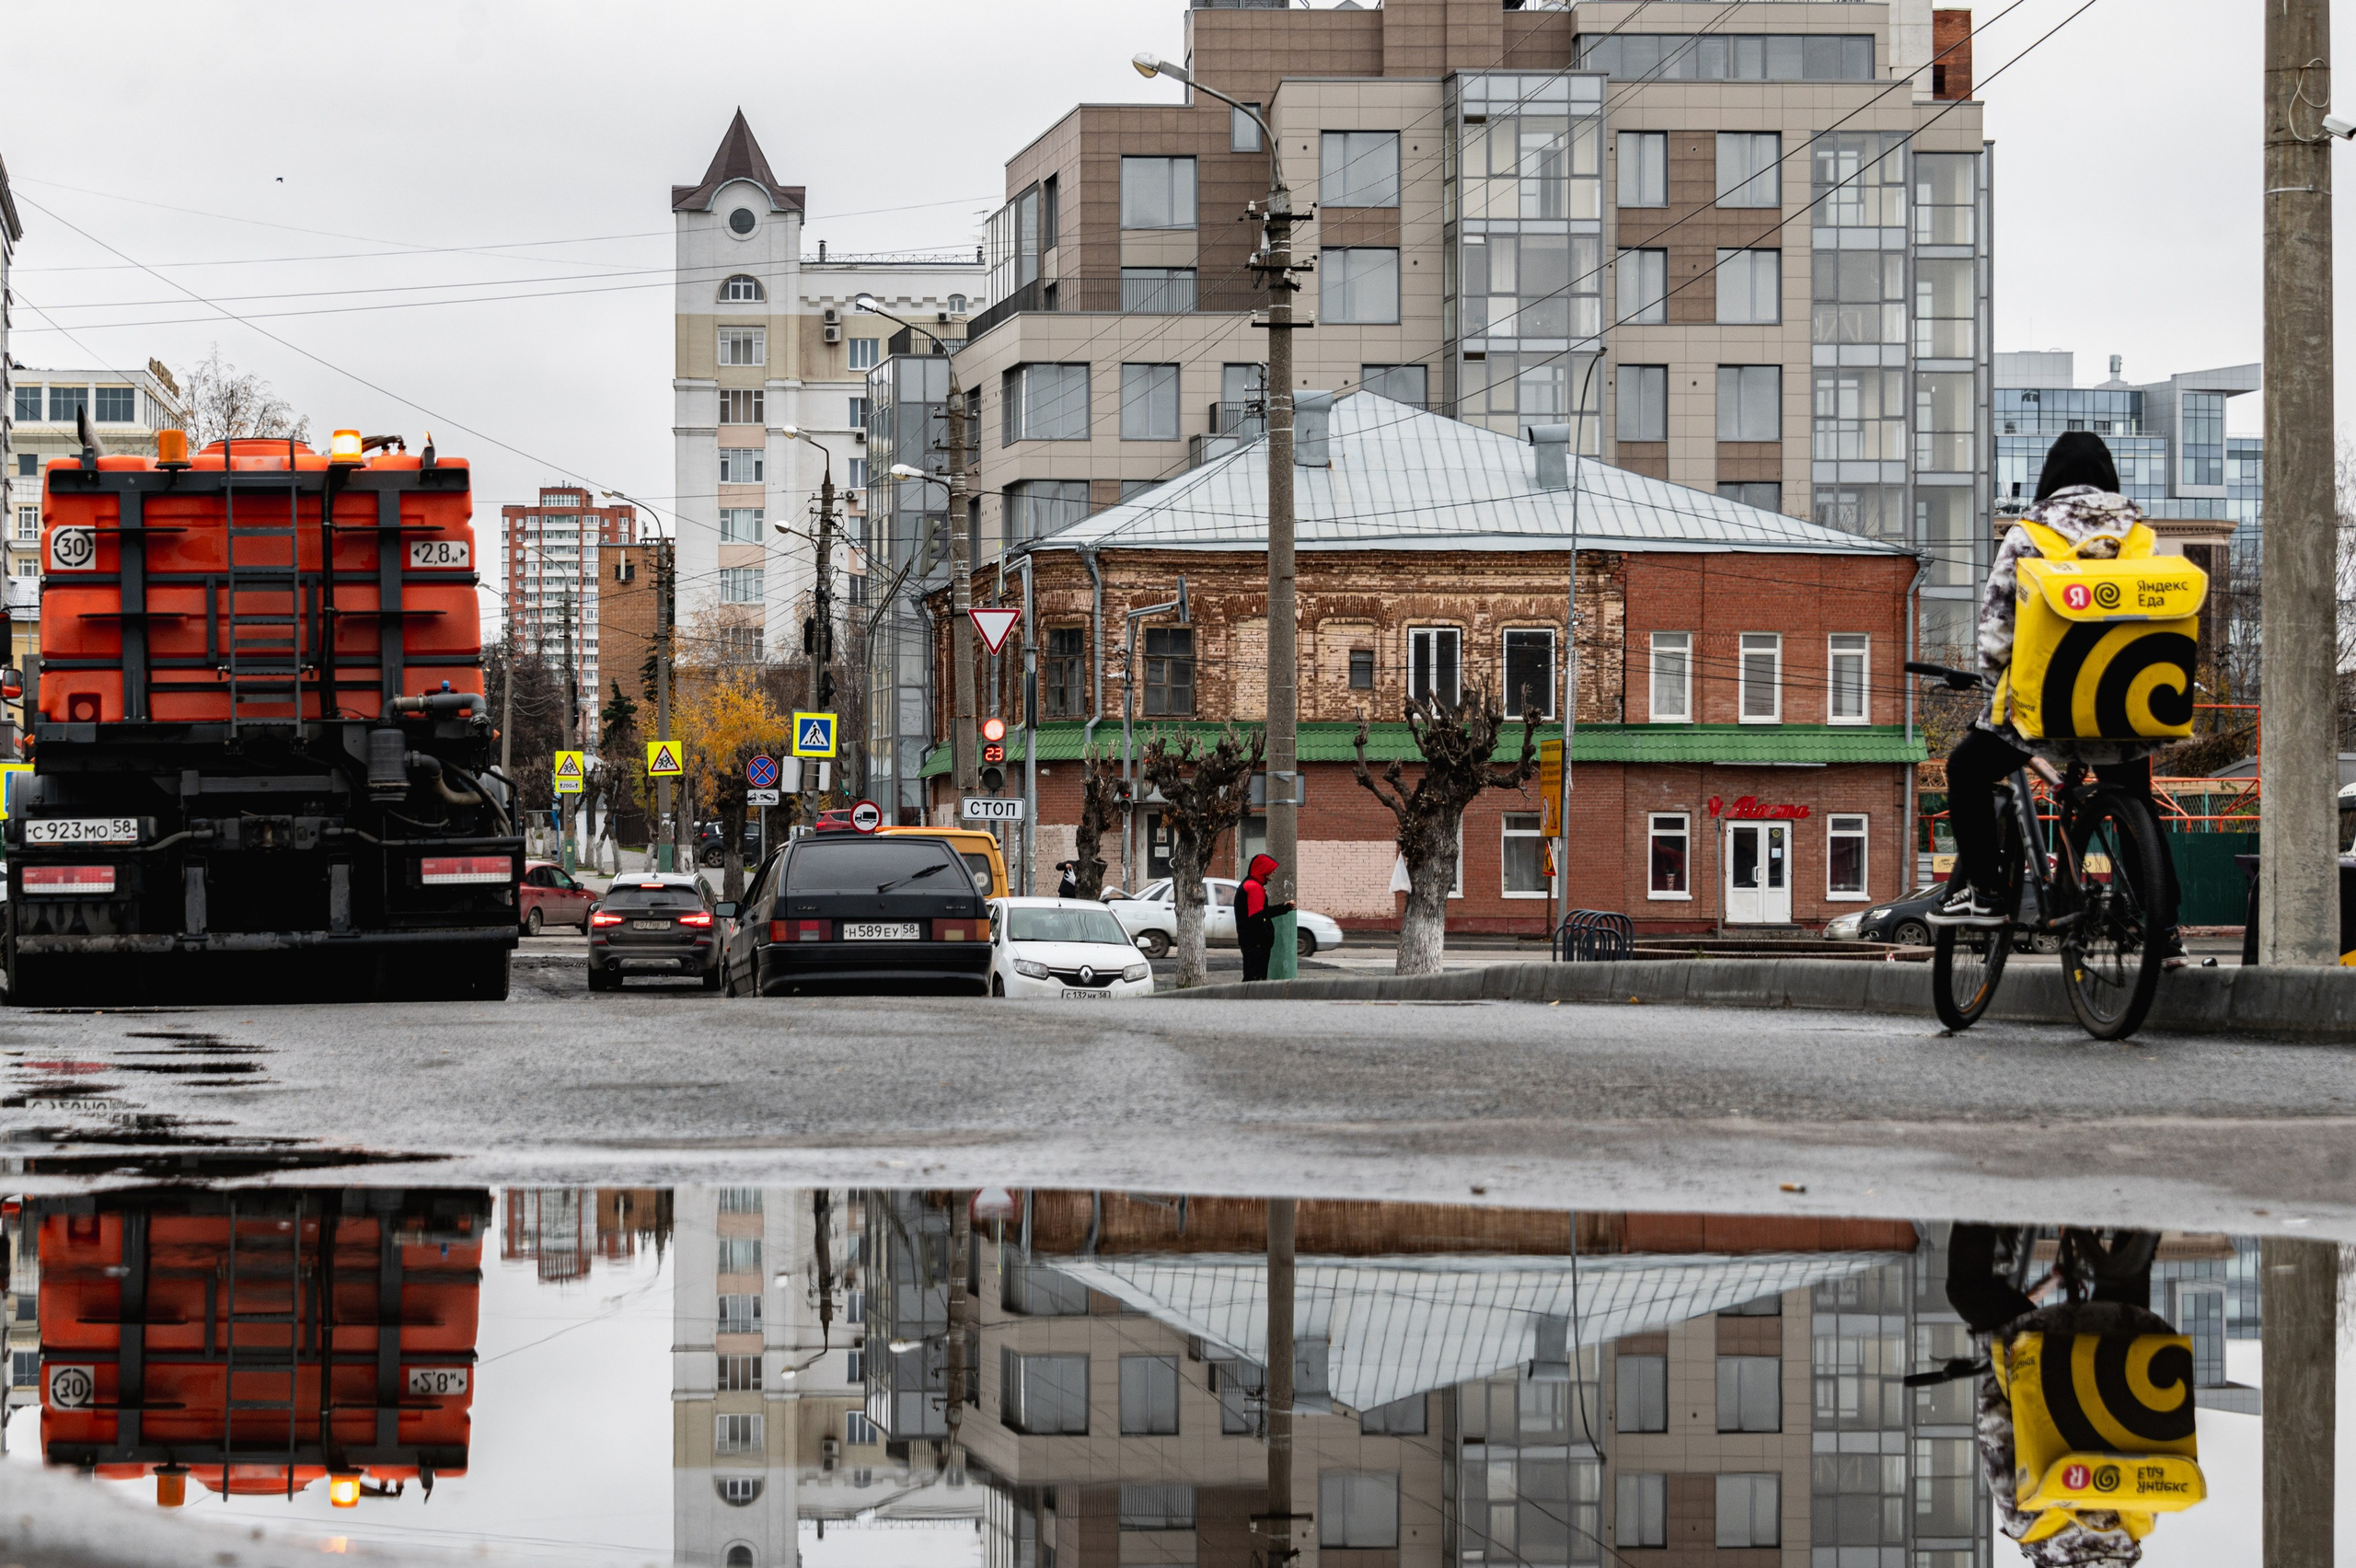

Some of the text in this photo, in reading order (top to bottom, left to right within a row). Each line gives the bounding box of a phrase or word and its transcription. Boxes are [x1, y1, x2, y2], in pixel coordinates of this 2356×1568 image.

[62, 538, 85, 557] 30
[2137, 580, 2189, 594] Яндекс
[2070, 586, 2085, 607] Я
[2138, 594, 2165, 607] Еда
[985, 746, 1003, 761] 23
[970, 801, 1016, 816] СТОП
[112, 820, 131, 834] 58
[903, 924, 916, 933] 58
